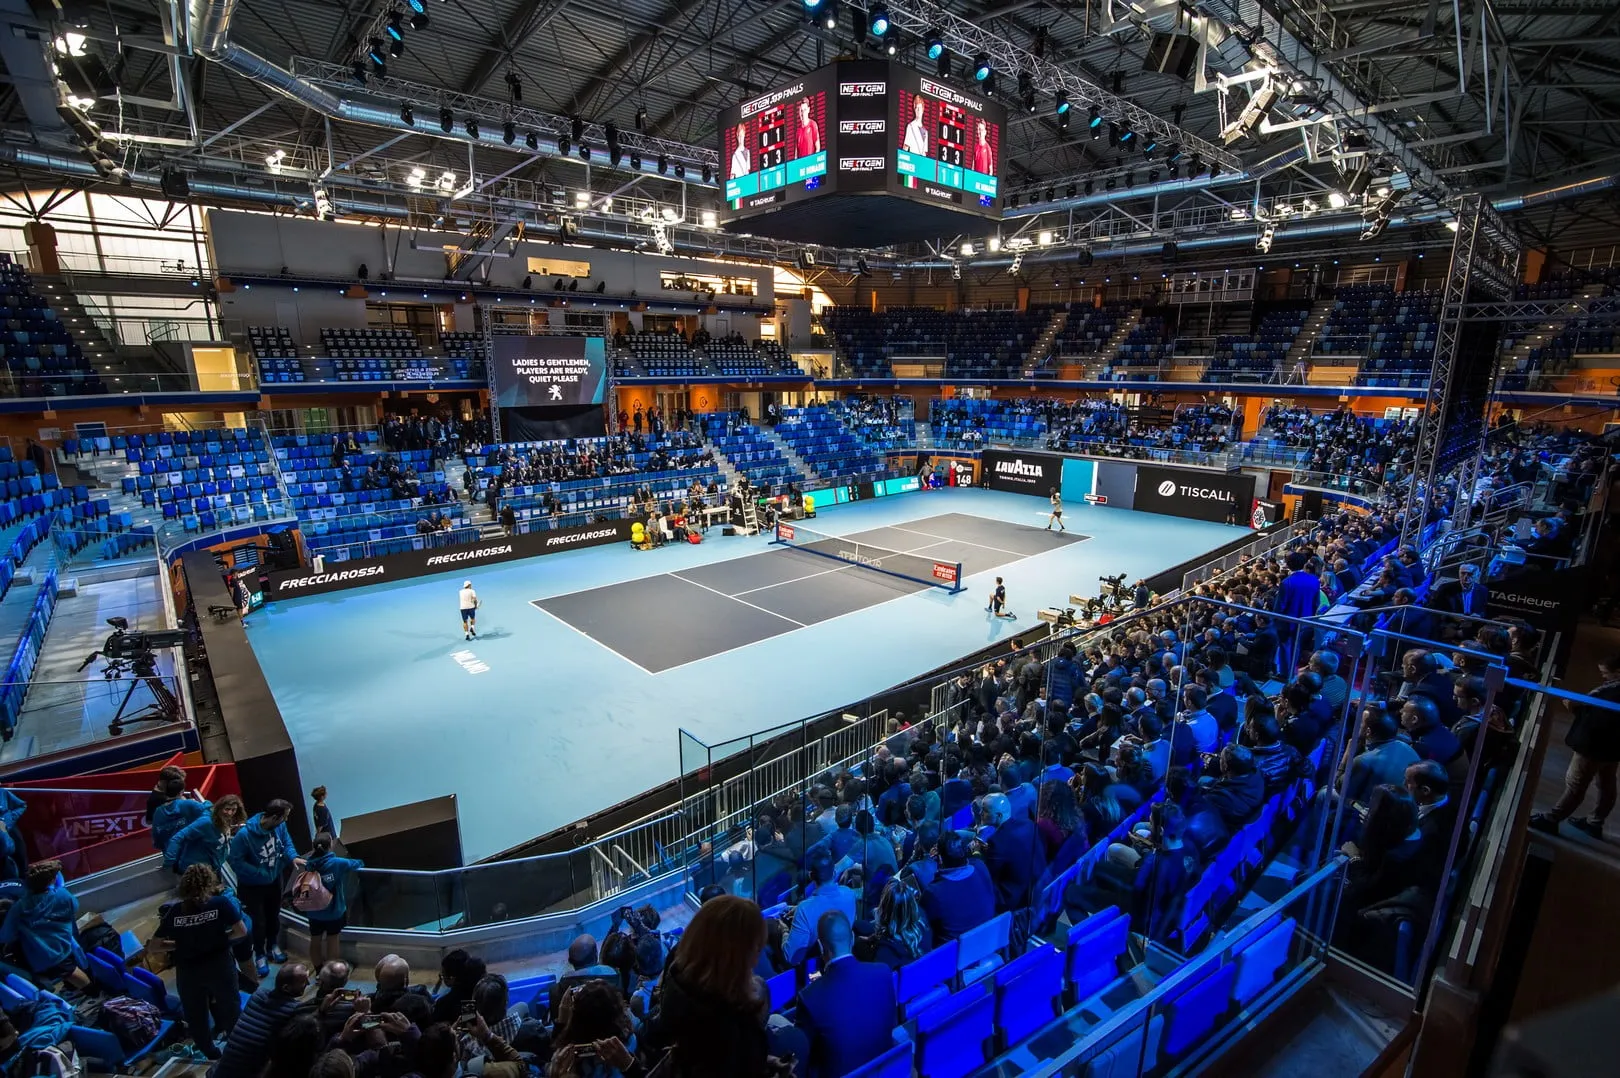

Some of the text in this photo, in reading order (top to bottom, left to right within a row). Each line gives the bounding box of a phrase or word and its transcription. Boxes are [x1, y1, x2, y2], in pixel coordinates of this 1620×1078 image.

[783, 83, 804, 99] FINALS
[964, 98, 983, 112] FINALS
[763, 128, 780, 147] 0 1
[942, 125, 948, 139] 0
[956, 130, 960, 144] 1
[763, 150, 781, 168] 3 3
[942, 147, 960, 165] 3 3
[517, 367, 588, 375] PLAYERS ARE READY,
[546, 359, 591, 367] GENTLEMEN,
[529, 375, 551, 384] QUIET
[995, 459, 1043, 477] LAVAZZA
[956, 475, 971, 485] 148
[1180, 485, 1230, 501] TISCALI
[546, 528, 617, 546] FRECCIAROSSA
[426, 545, 512, 566] FRECCIAROSSA
[279, 565, 384, 590] FRECCIAROSSA
[72, 815, 138, 835] NEXT
